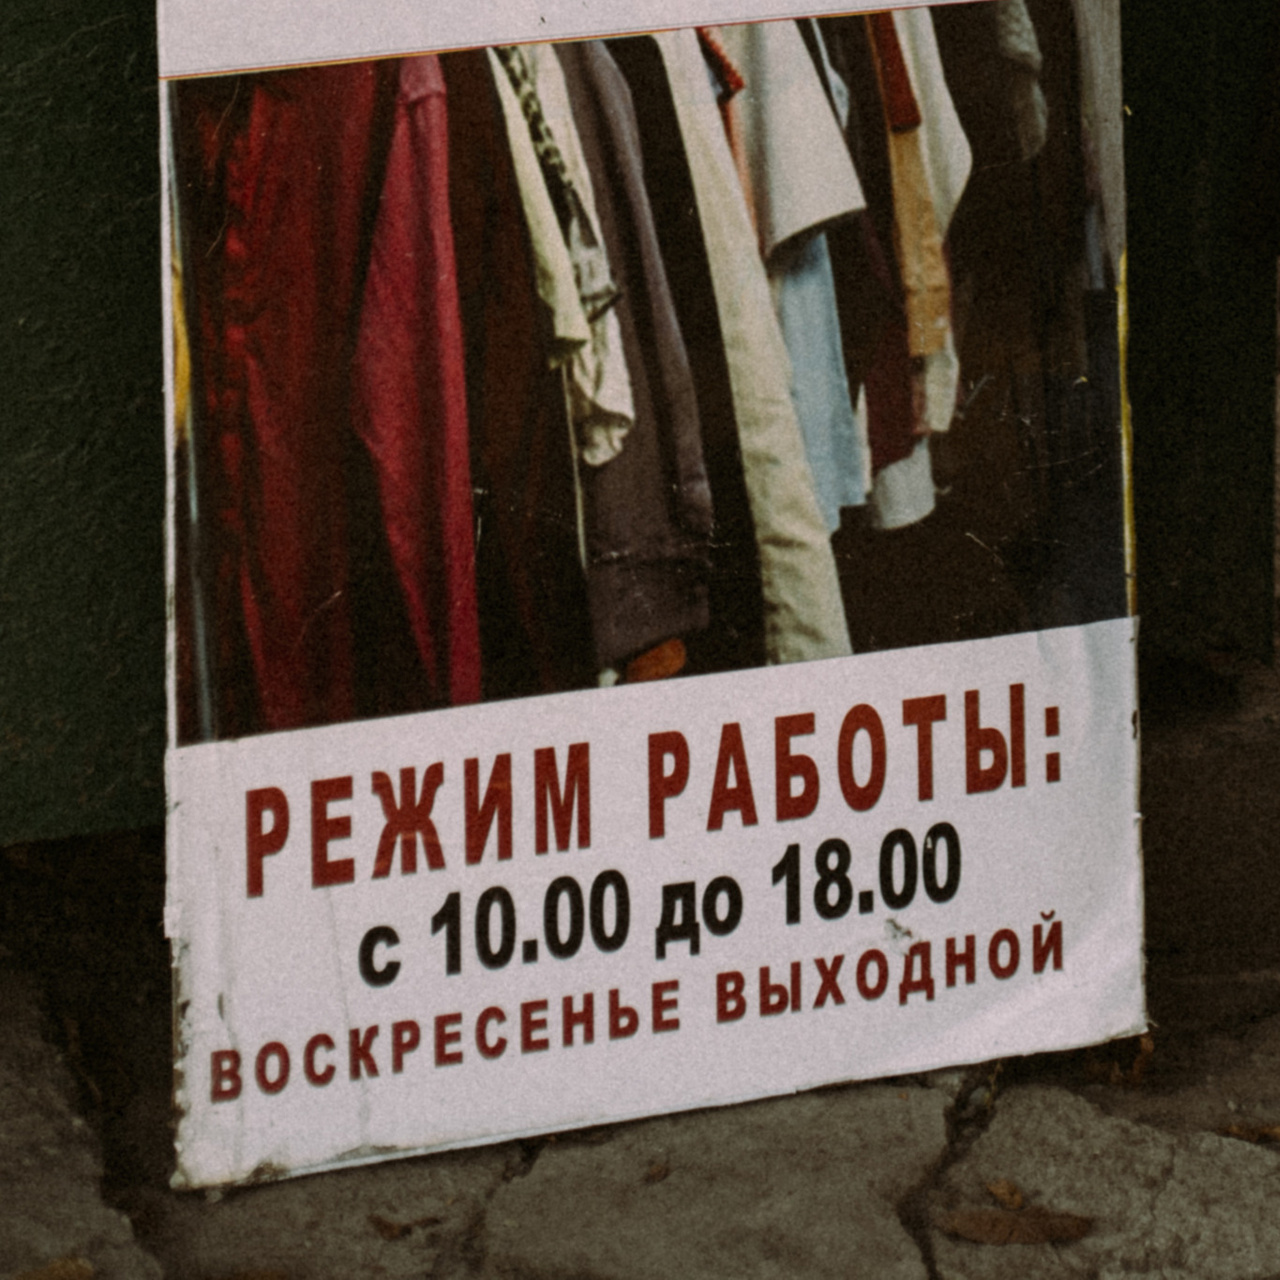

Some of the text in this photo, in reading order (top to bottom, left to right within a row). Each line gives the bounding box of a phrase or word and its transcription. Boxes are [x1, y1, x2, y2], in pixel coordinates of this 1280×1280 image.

[245, 682, 1064, 899] РЕЖИМ РАБОТЫ:
[430, 869, 631, 975] 10.00
[654, 874, 743, 958] до
[771, 821, 962, 926] 18.00
[210, 911, 1066, 1103] ВОСКРЕСЕНЬЕ ВЫХОДНОЙ
